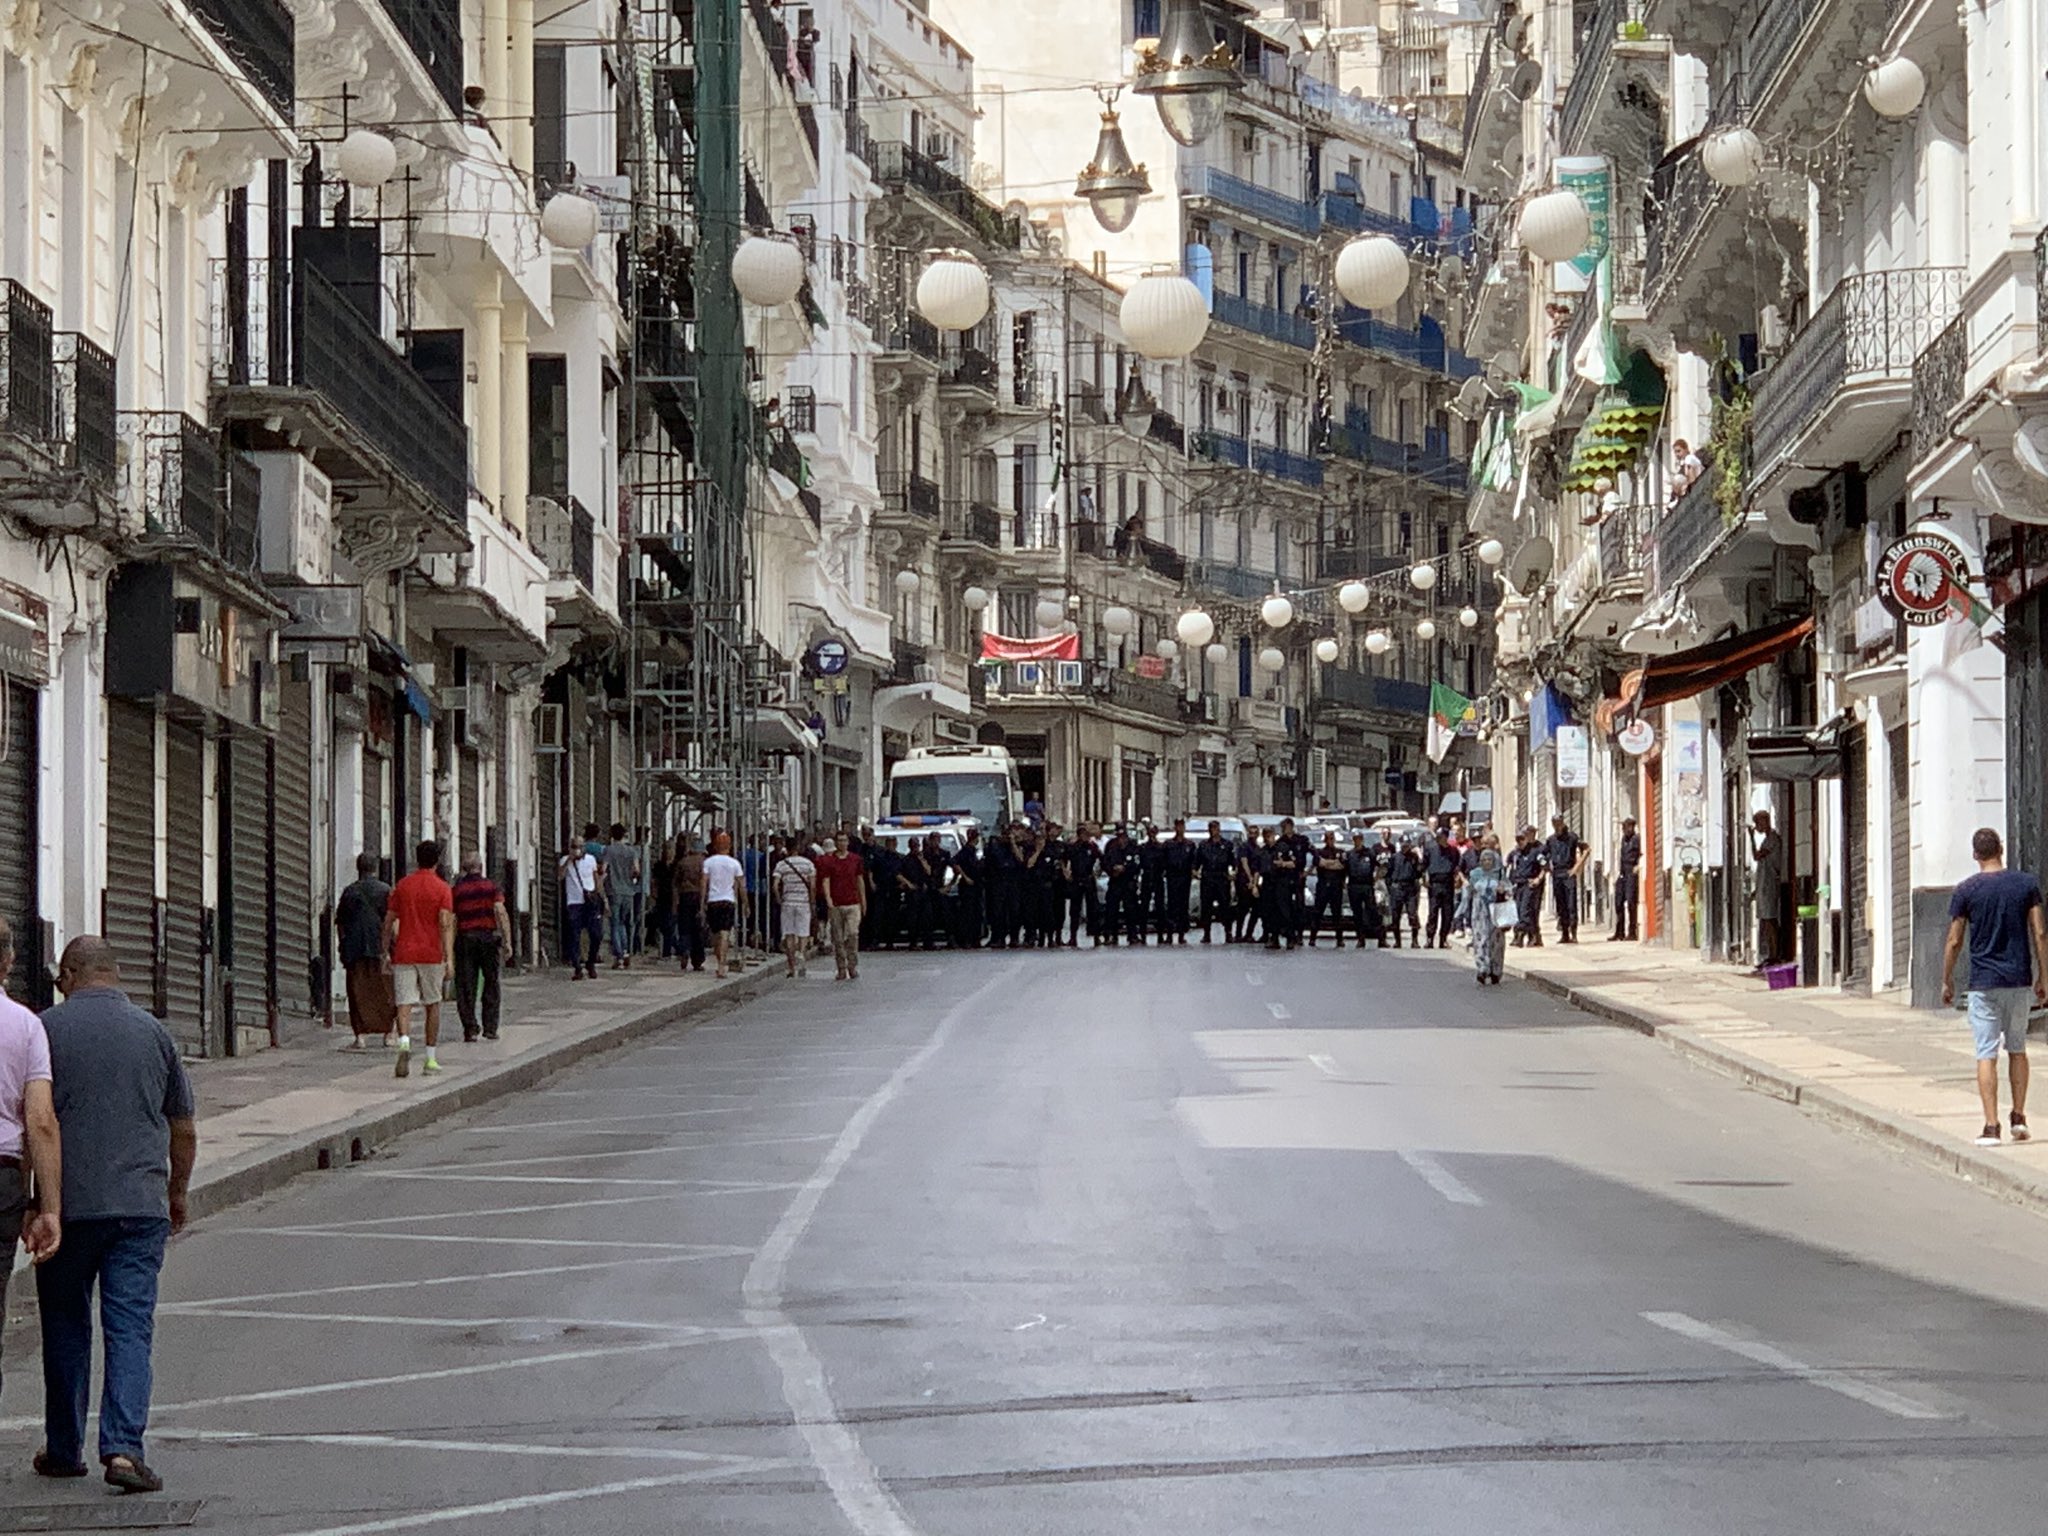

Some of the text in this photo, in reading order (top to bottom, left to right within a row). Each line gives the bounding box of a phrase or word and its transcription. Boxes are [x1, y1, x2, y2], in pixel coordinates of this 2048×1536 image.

[1878, 537, 1963, 579] Le Brunswick
[1903, 609, 1946, 624] Coffe
